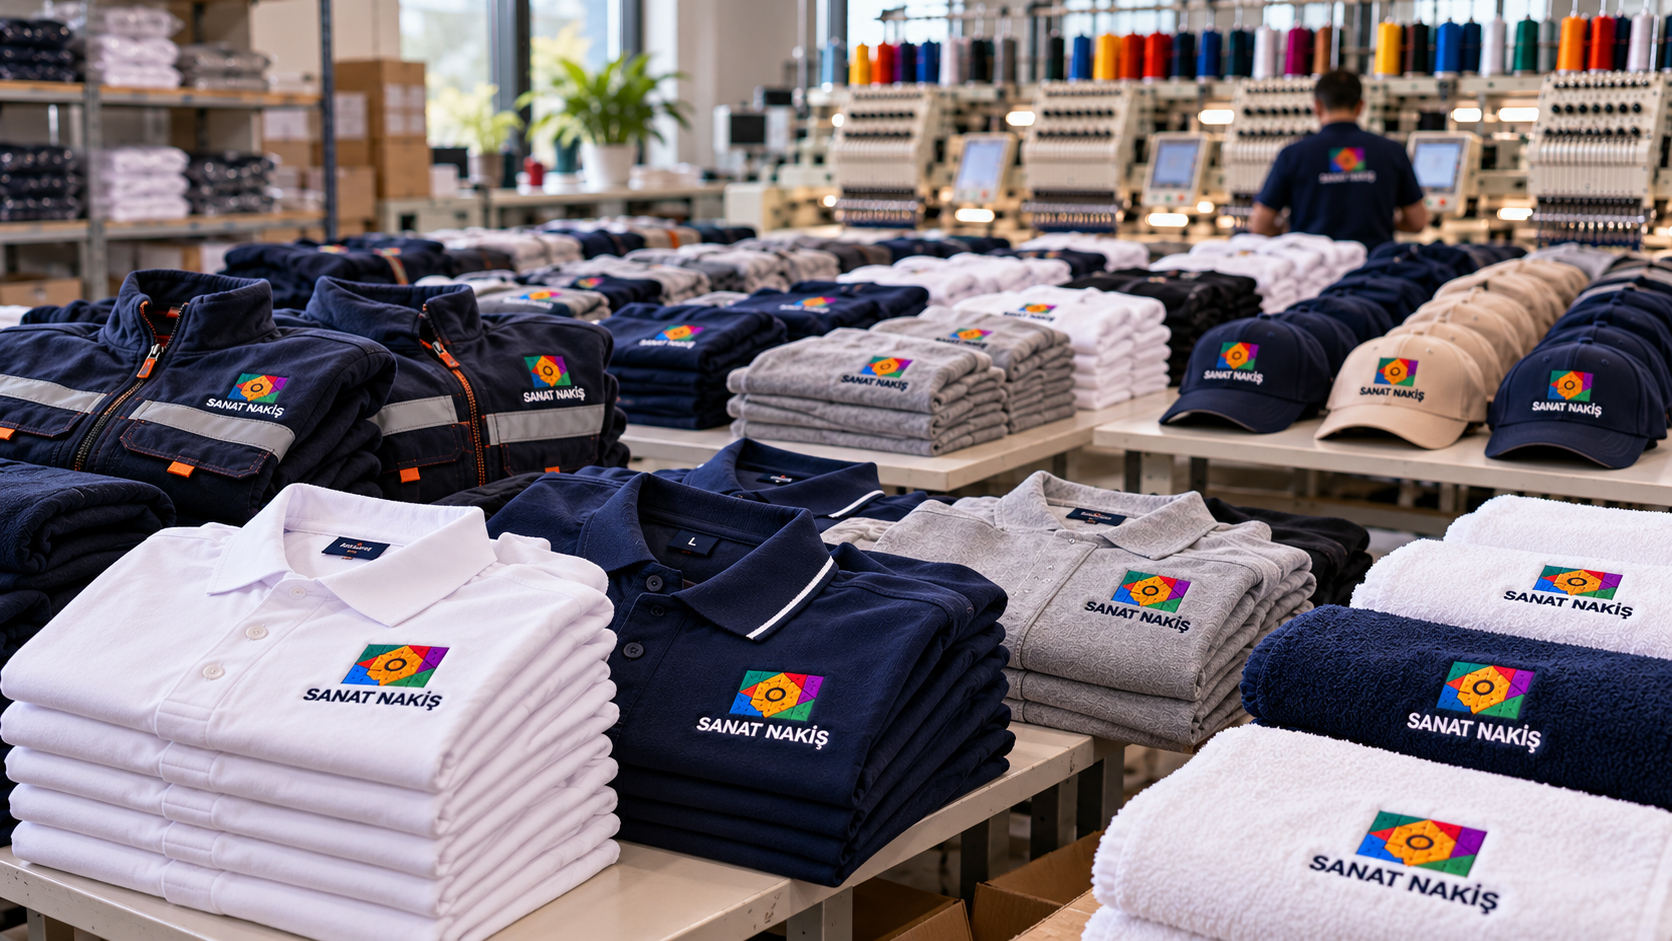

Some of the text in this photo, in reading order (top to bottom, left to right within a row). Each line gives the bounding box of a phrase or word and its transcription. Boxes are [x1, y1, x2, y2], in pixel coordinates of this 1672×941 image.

[1203, 370, 1233, 380] SANAT
[523, 390, 554, 402] SANAT
[1359, 387, 1392, 396] SANAT
[206, 398, 284, 418] SANAT NAKİŞ
[1532, 401, 1602, 418] SANAT NAKİŞ
[688, 537, 697, 546] L
[1504, 590, 1634, 620] SANAT NAKİŞ
[1084, 601, 1191, 634] SANAT NAKİŞ
[303, 688, 443, 711] SANAT NAKİŞ
[696, 716, 830, 750] SANAT NAKİŞ
[1406, 712, 1542, 754] SANAT NAKİŞ
[1308, 855, 1500, 915] SANAT NAKİŞ
